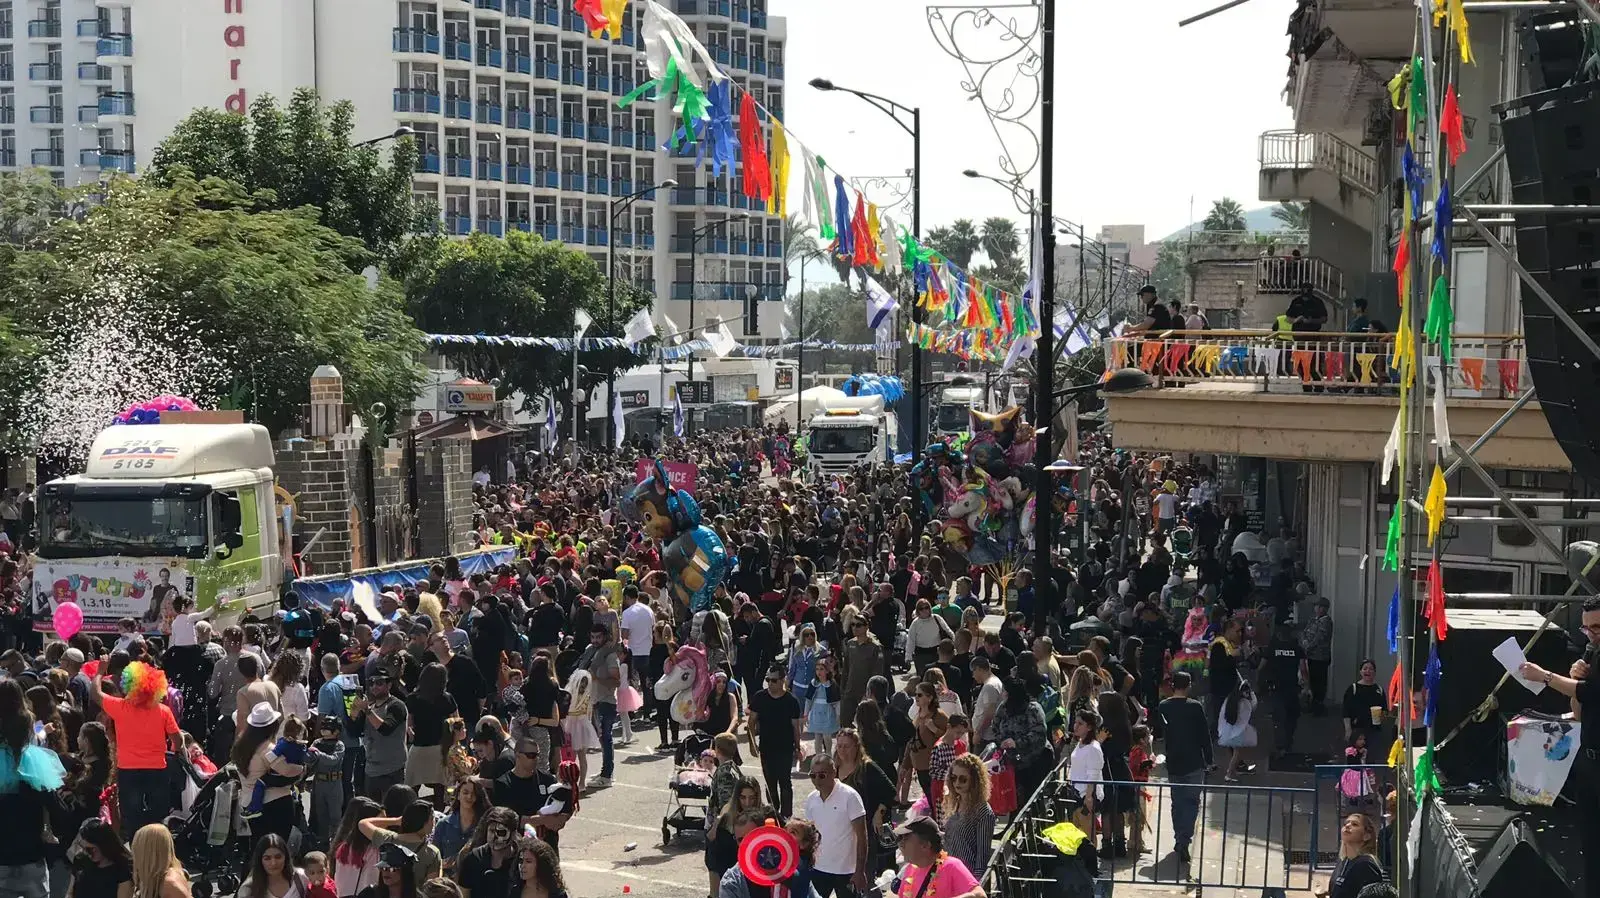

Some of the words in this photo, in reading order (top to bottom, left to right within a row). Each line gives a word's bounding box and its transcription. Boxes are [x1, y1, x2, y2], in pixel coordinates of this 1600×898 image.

[102, 447, 180, 455] DAF
[113, 459, 156, 469] 5185
[81, 598, 112, 609] 1.3.18
